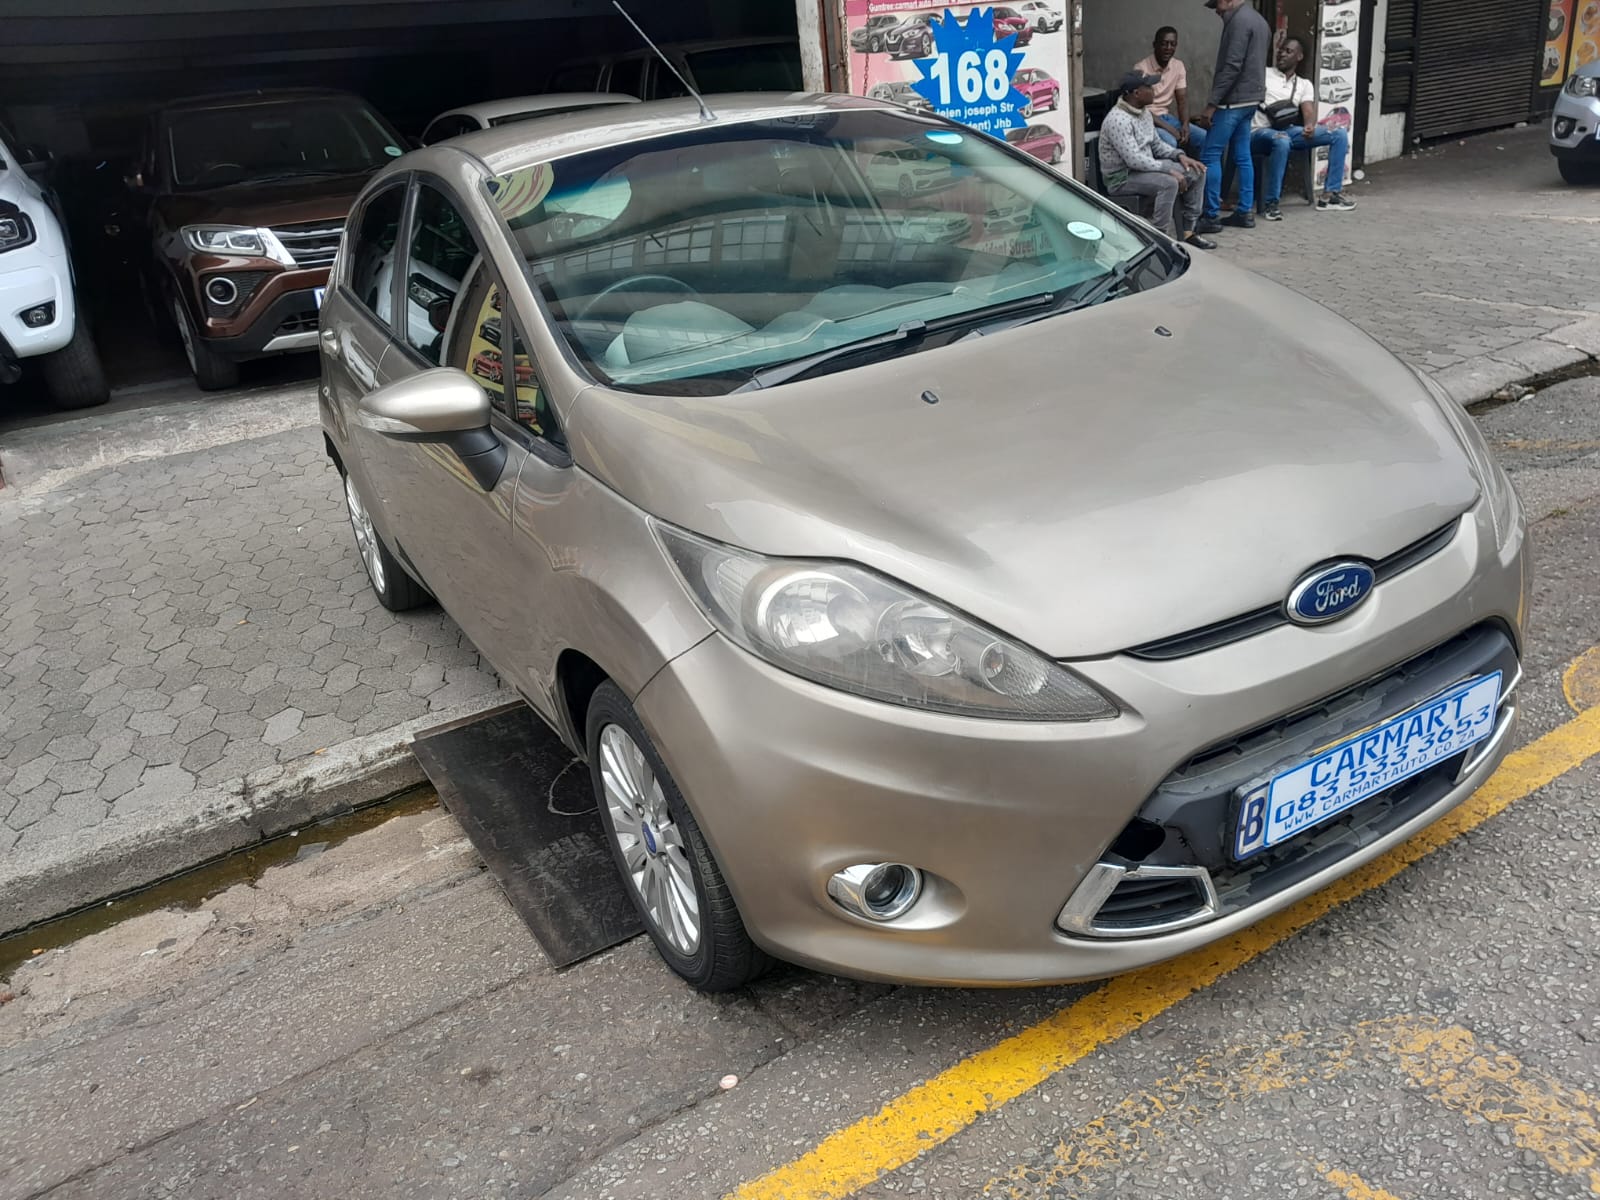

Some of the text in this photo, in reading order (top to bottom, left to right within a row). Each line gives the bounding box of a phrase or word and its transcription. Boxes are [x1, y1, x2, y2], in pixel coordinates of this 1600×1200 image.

[930, 49, 1010, 105] 168
[964, 103, 997, 119] joseph
[1000, 102, 1014, 113] Str
[994, 118, 1012, 129] Jhb
[1315, 574, 1361, 612] Ford
[1310, 691, 1470, 788] CARMART
[1275, 703, 1491, 824] 083 533 3653
